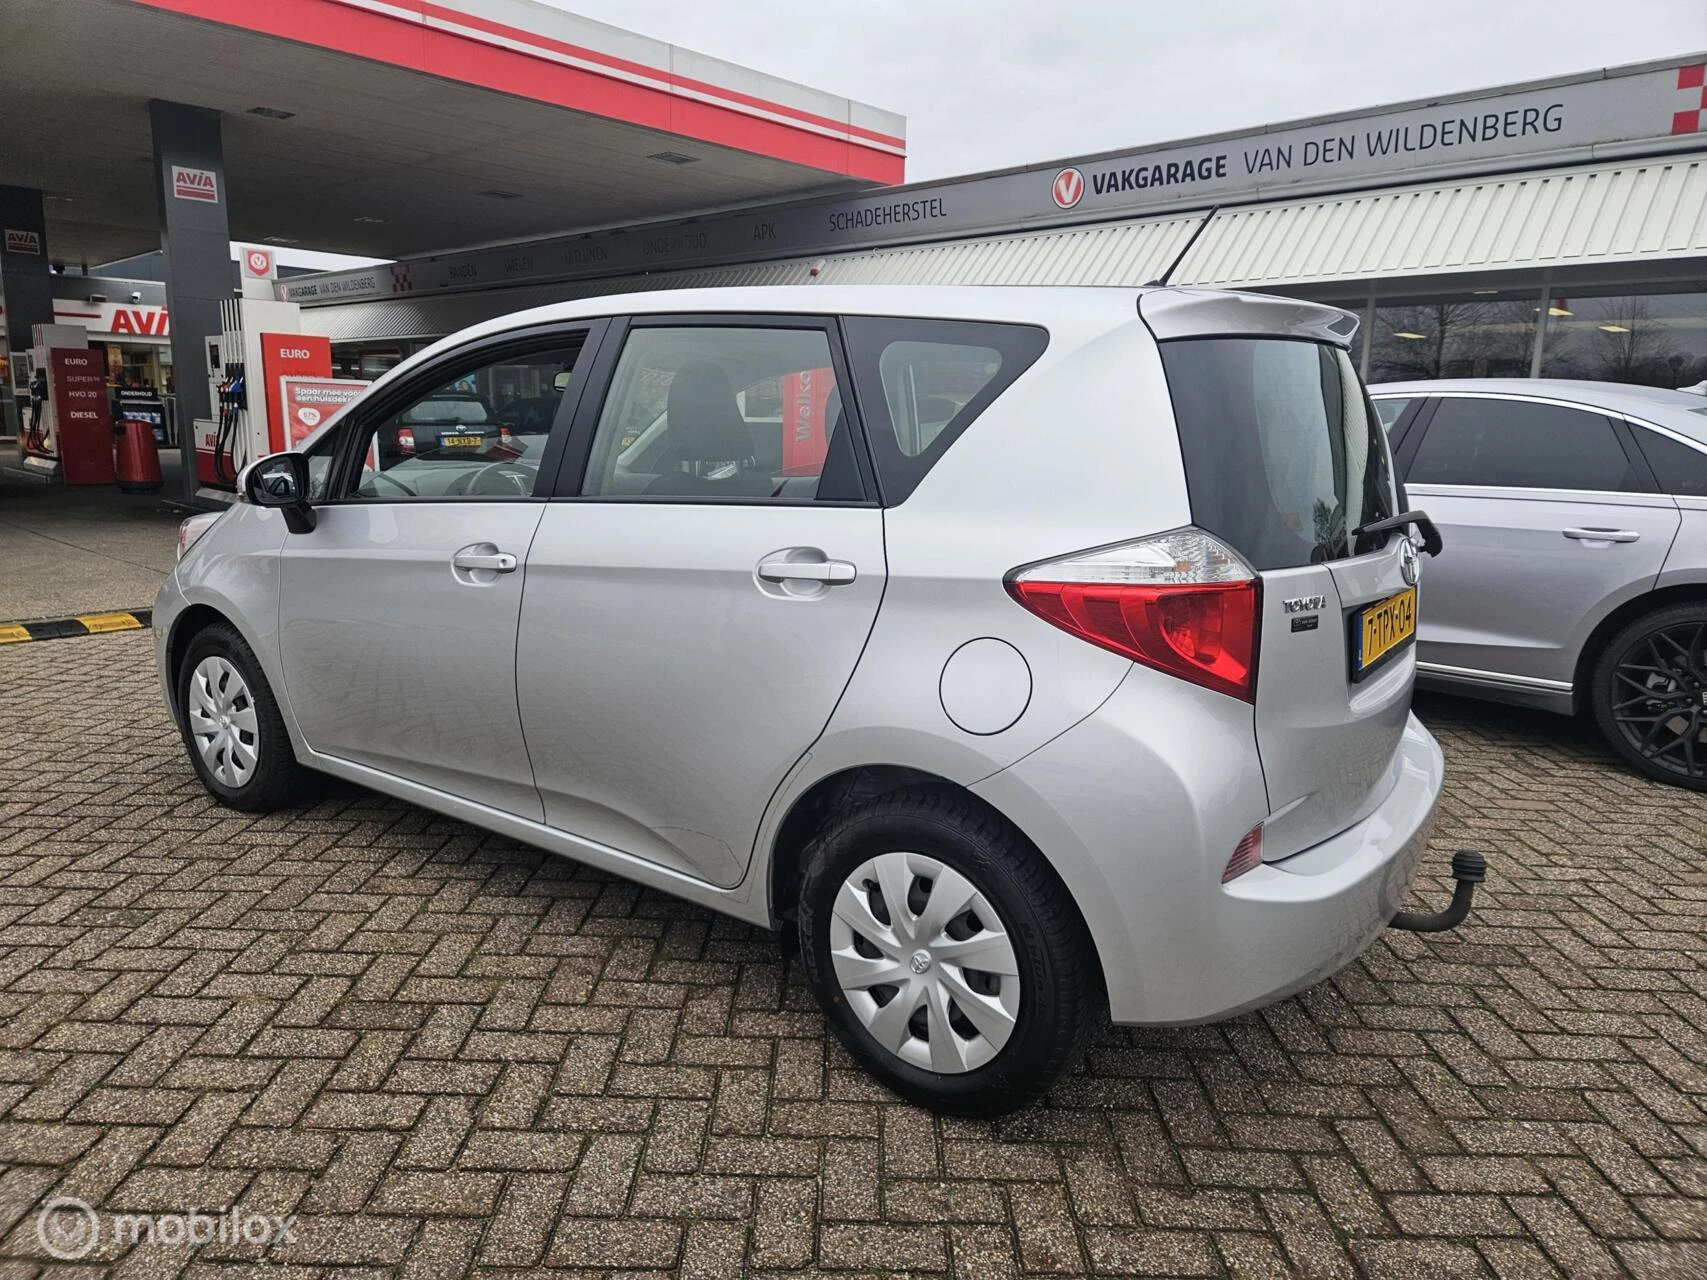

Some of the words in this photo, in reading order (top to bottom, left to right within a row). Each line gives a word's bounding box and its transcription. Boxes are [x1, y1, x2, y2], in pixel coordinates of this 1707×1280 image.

[1092, 154, 1228, 195] VAKGARAGE
[1243, 144, 1293, 175] VAN
[1303, 134, 1356, 167] DEN
[1366, 104, 1565, 157] WILDENBERG
[175, 171, 215, 188] AVIA
[829, 197, 948, 232] SCHADEHERSTEL
[7, 230, 38, 244] AVIA
[753, 222, 778, 241] APK
[288, 284, 318, 297] VAKGARAGE
[319, 283, 330, 295] VAN
[330, 282, 341, 293] DEN
[342, 277, 376, 292] WILDENBERG
[111, 305, 169, 336] AVI
[64, 358, 88, 366] EURO
[280, 348, 310, 359] EURO
[66, 375, 93, 383] SUPER
[68, 390, 86, 398] HVO
[295, 387, 321, 396] Spaar
[70, 410, 99, 419] DIESEL
[795, 370, 811, 444] Welko
[1282, 595, 1326, 614] TOYOTA
[1367, 594, 1412, 657] 7-TPX-04
